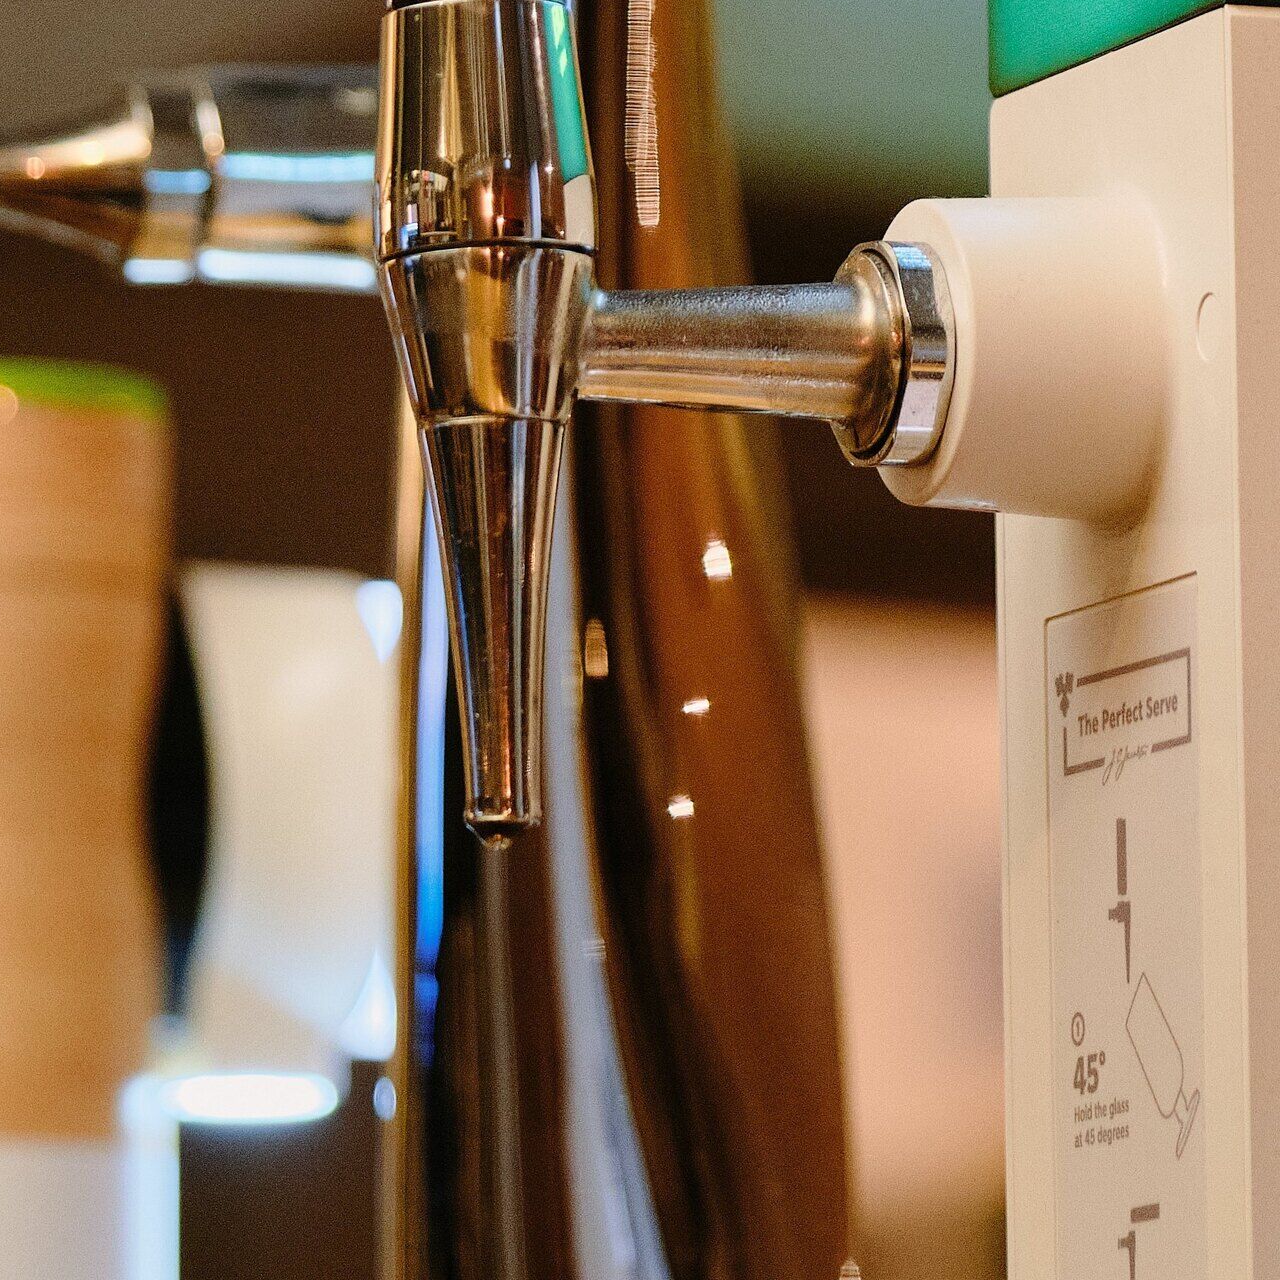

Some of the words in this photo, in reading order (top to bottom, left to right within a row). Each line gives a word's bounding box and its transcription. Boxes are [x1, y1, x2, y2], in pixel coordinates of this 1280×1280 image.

[1077, 713, 1099, 737] The
[1102, 701, 1143, 731] Perfect
[1146, 694, 1178, 720] Serve
[1074, 1102, 1093, 1123] Hold
[1094, 1101, 1108, 1120] the
[1109, 1096, 1130, 1120] glass
[1074, 1131, 1083, 1149] at
[1085, 1127, 1095, 1146] 45
[1096, 1124, 1130, 1146] degrees
